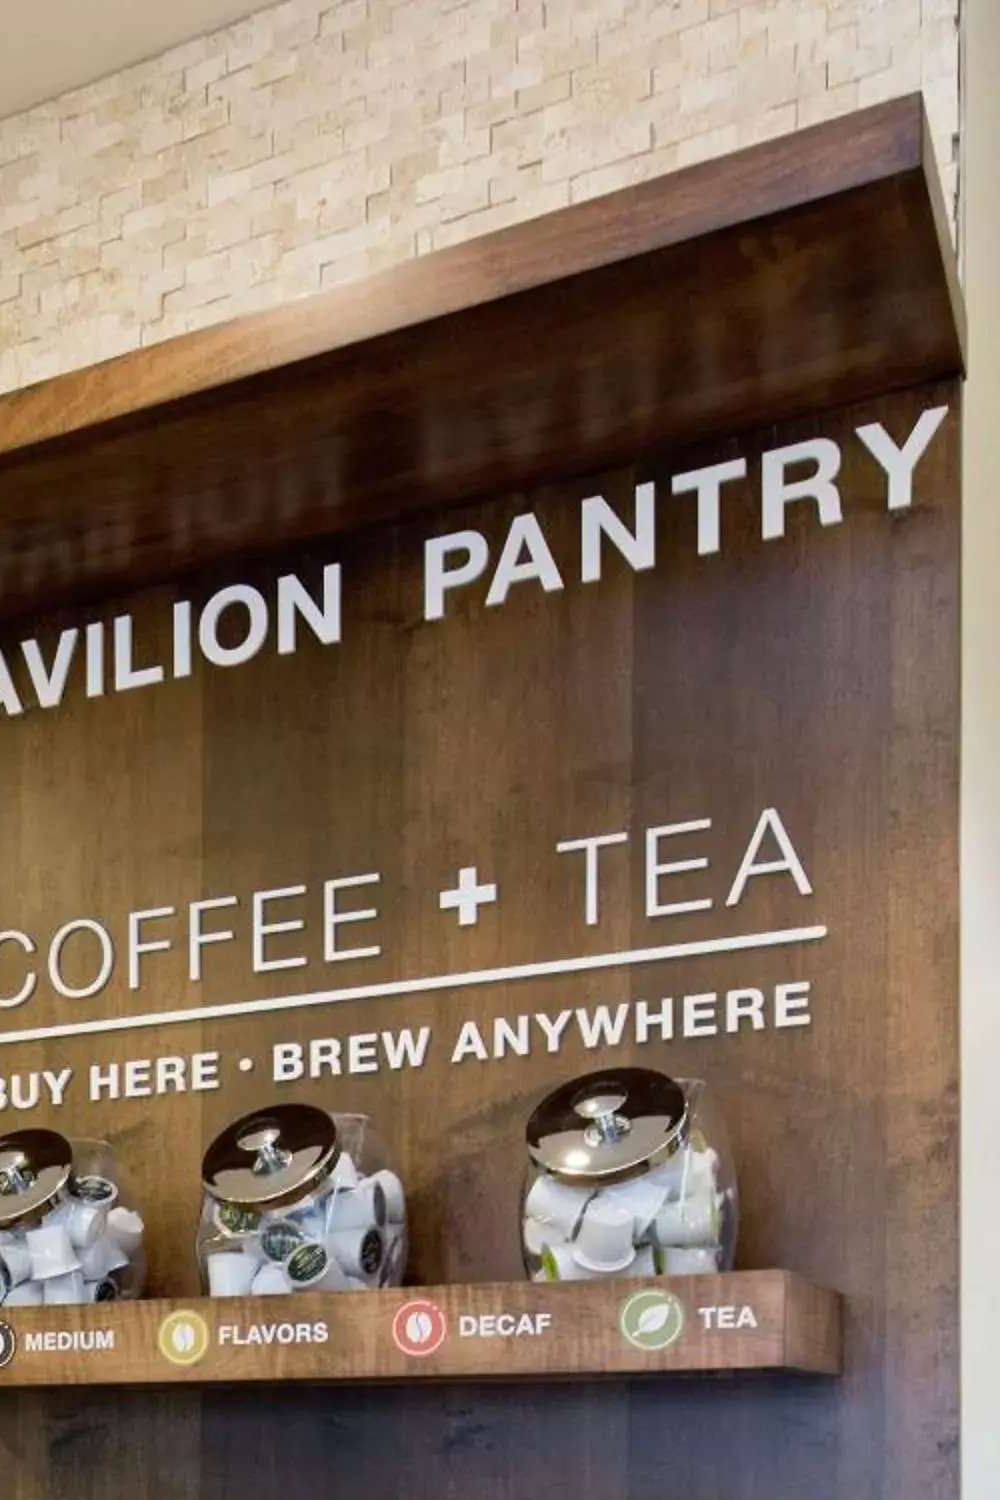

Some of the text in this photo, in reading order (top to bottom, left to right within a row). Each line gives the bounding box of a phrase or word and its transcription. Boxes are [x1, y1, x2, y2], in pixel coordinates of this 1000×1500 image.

[424, 405, 949, 620] PANTRY
[556, 807, 813, 926] TEA
[89, 1051, 219, 1101] HERE
[273, 1026, 430, 1081] BREW
[451, 981, 811, 1063] ANYWHERE
[459, 1312, 552, 1338] DECAF
[698, 1305, 758, 1329] TEA
[24, 1329, 115, 1352] MEDIUM
[218, 1321, 329, 1345] FLAVORS
